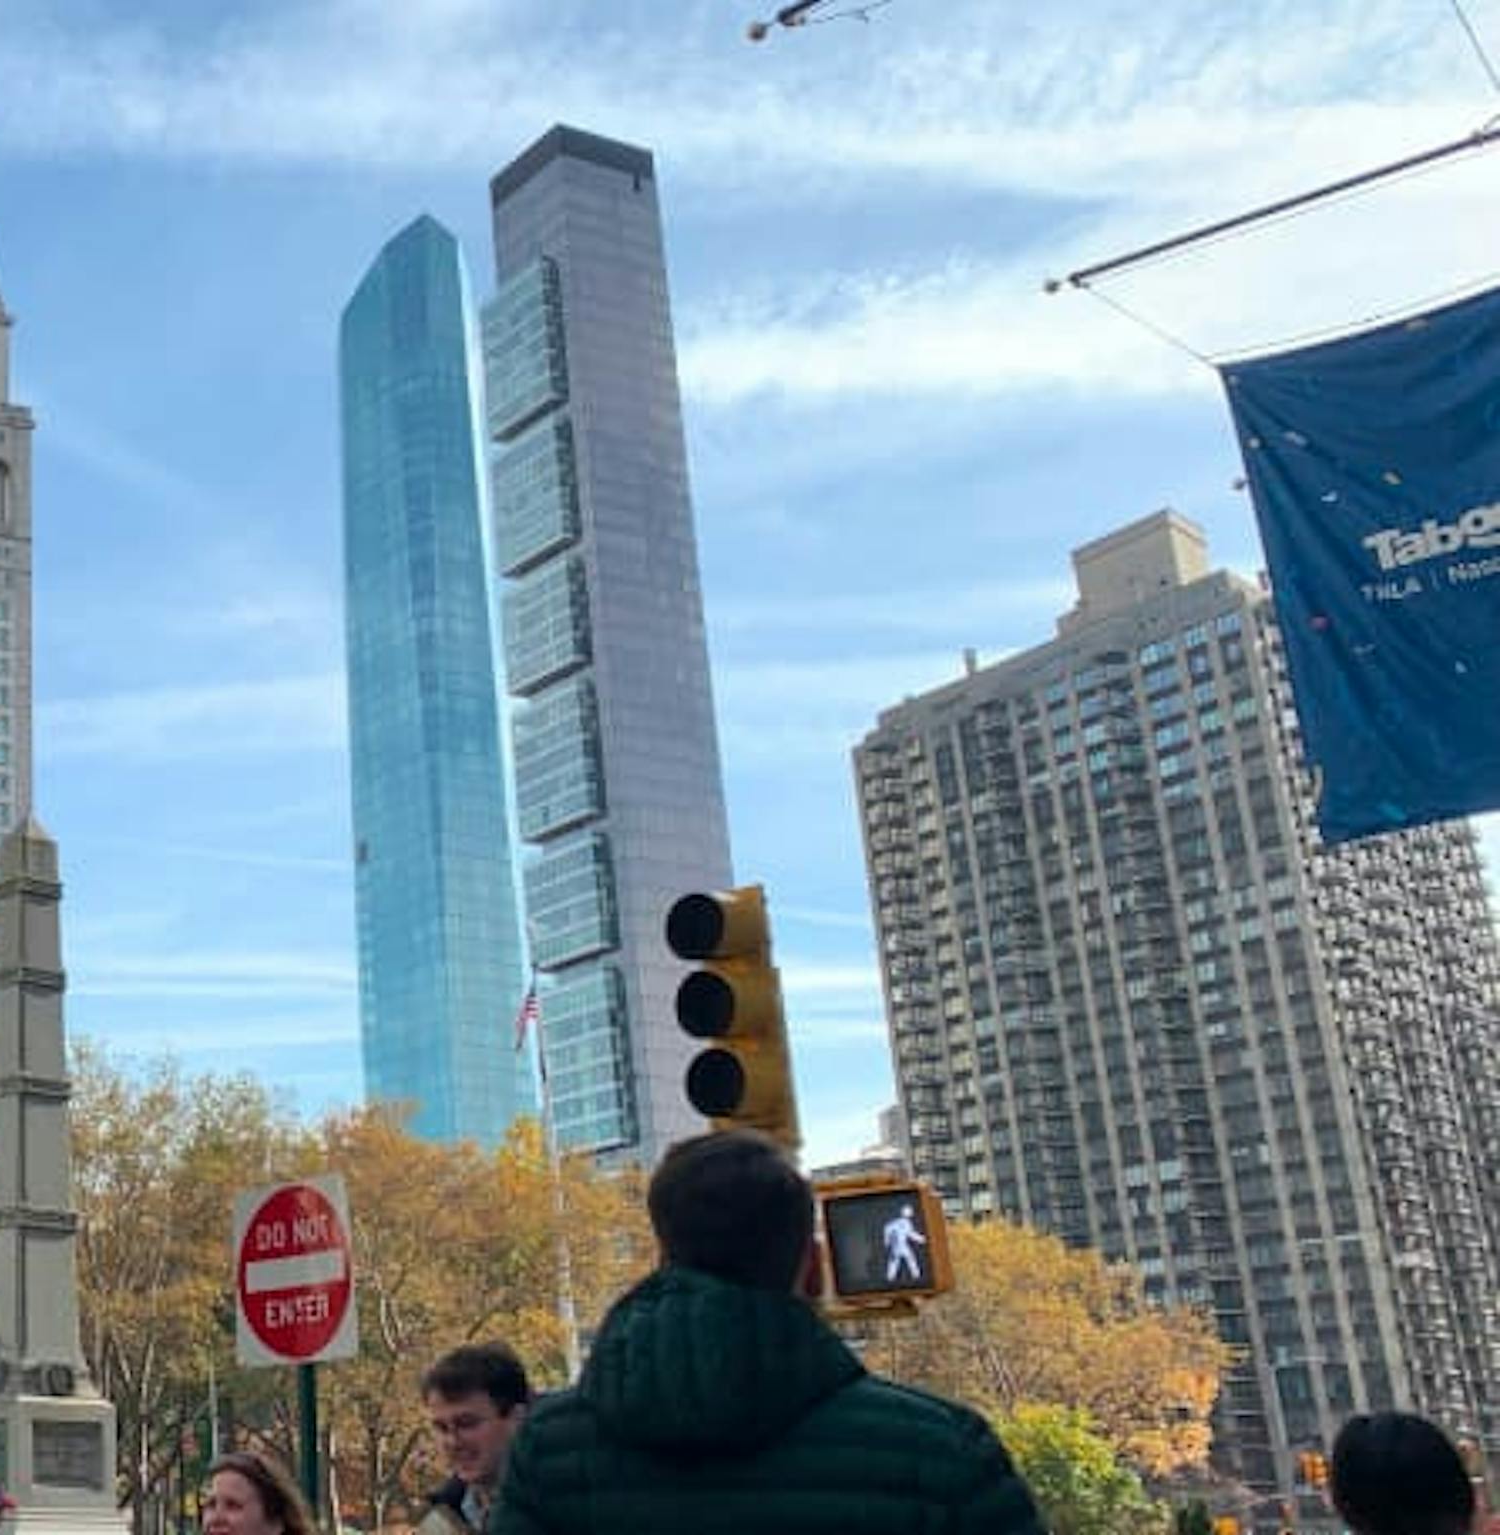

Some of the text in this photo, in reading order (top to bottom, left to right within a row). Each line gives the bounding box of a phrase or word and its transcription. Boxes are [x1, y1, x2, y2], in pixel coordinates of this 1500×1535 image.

[255, 1214, 329, 1251] DO NOT
[264, 1293, 330, 1330] ENTER
